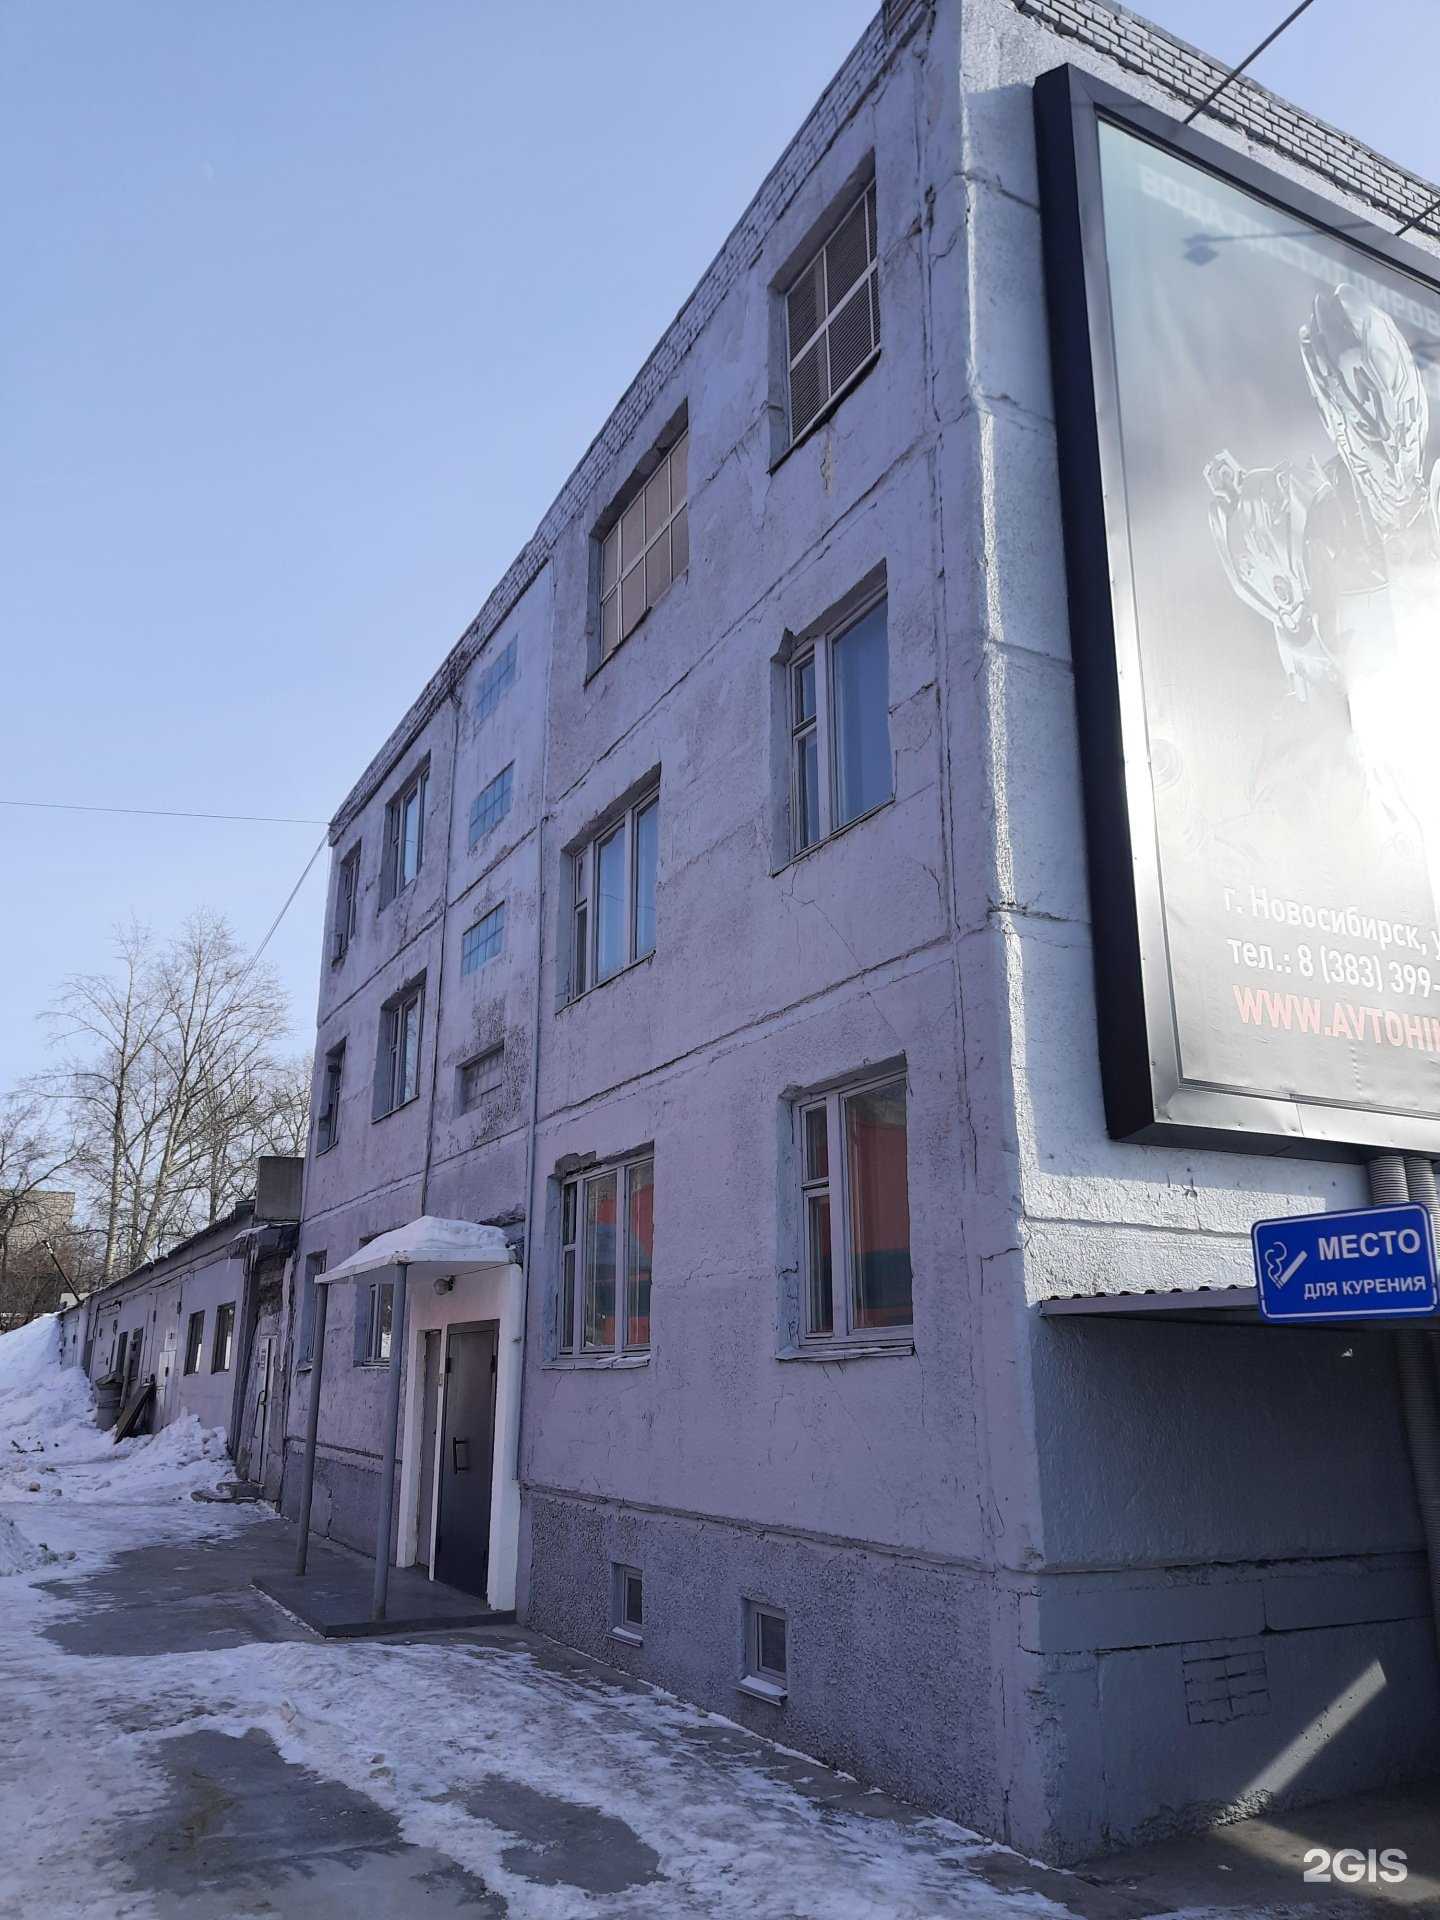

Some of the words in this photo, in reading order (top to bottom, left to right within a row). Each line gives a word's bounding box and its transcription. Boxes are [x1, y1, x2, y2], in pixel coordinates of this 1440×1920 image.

[1224, 886, 1243, 914] г.
[1250, 884, 1427, 957] Новосибирск,
[1227, 937, 1292, 974] тел.:
[1298, 944, 1314, 977] 8
[1320, 945, 1382, 993] (383)
[1318, 1228, 1421, 1261] МЕСТО
[1303, 1280, 1338, 1301] ДЛЯ
[1343, 1275, 1427, 1296] КУРЕНИЯ
